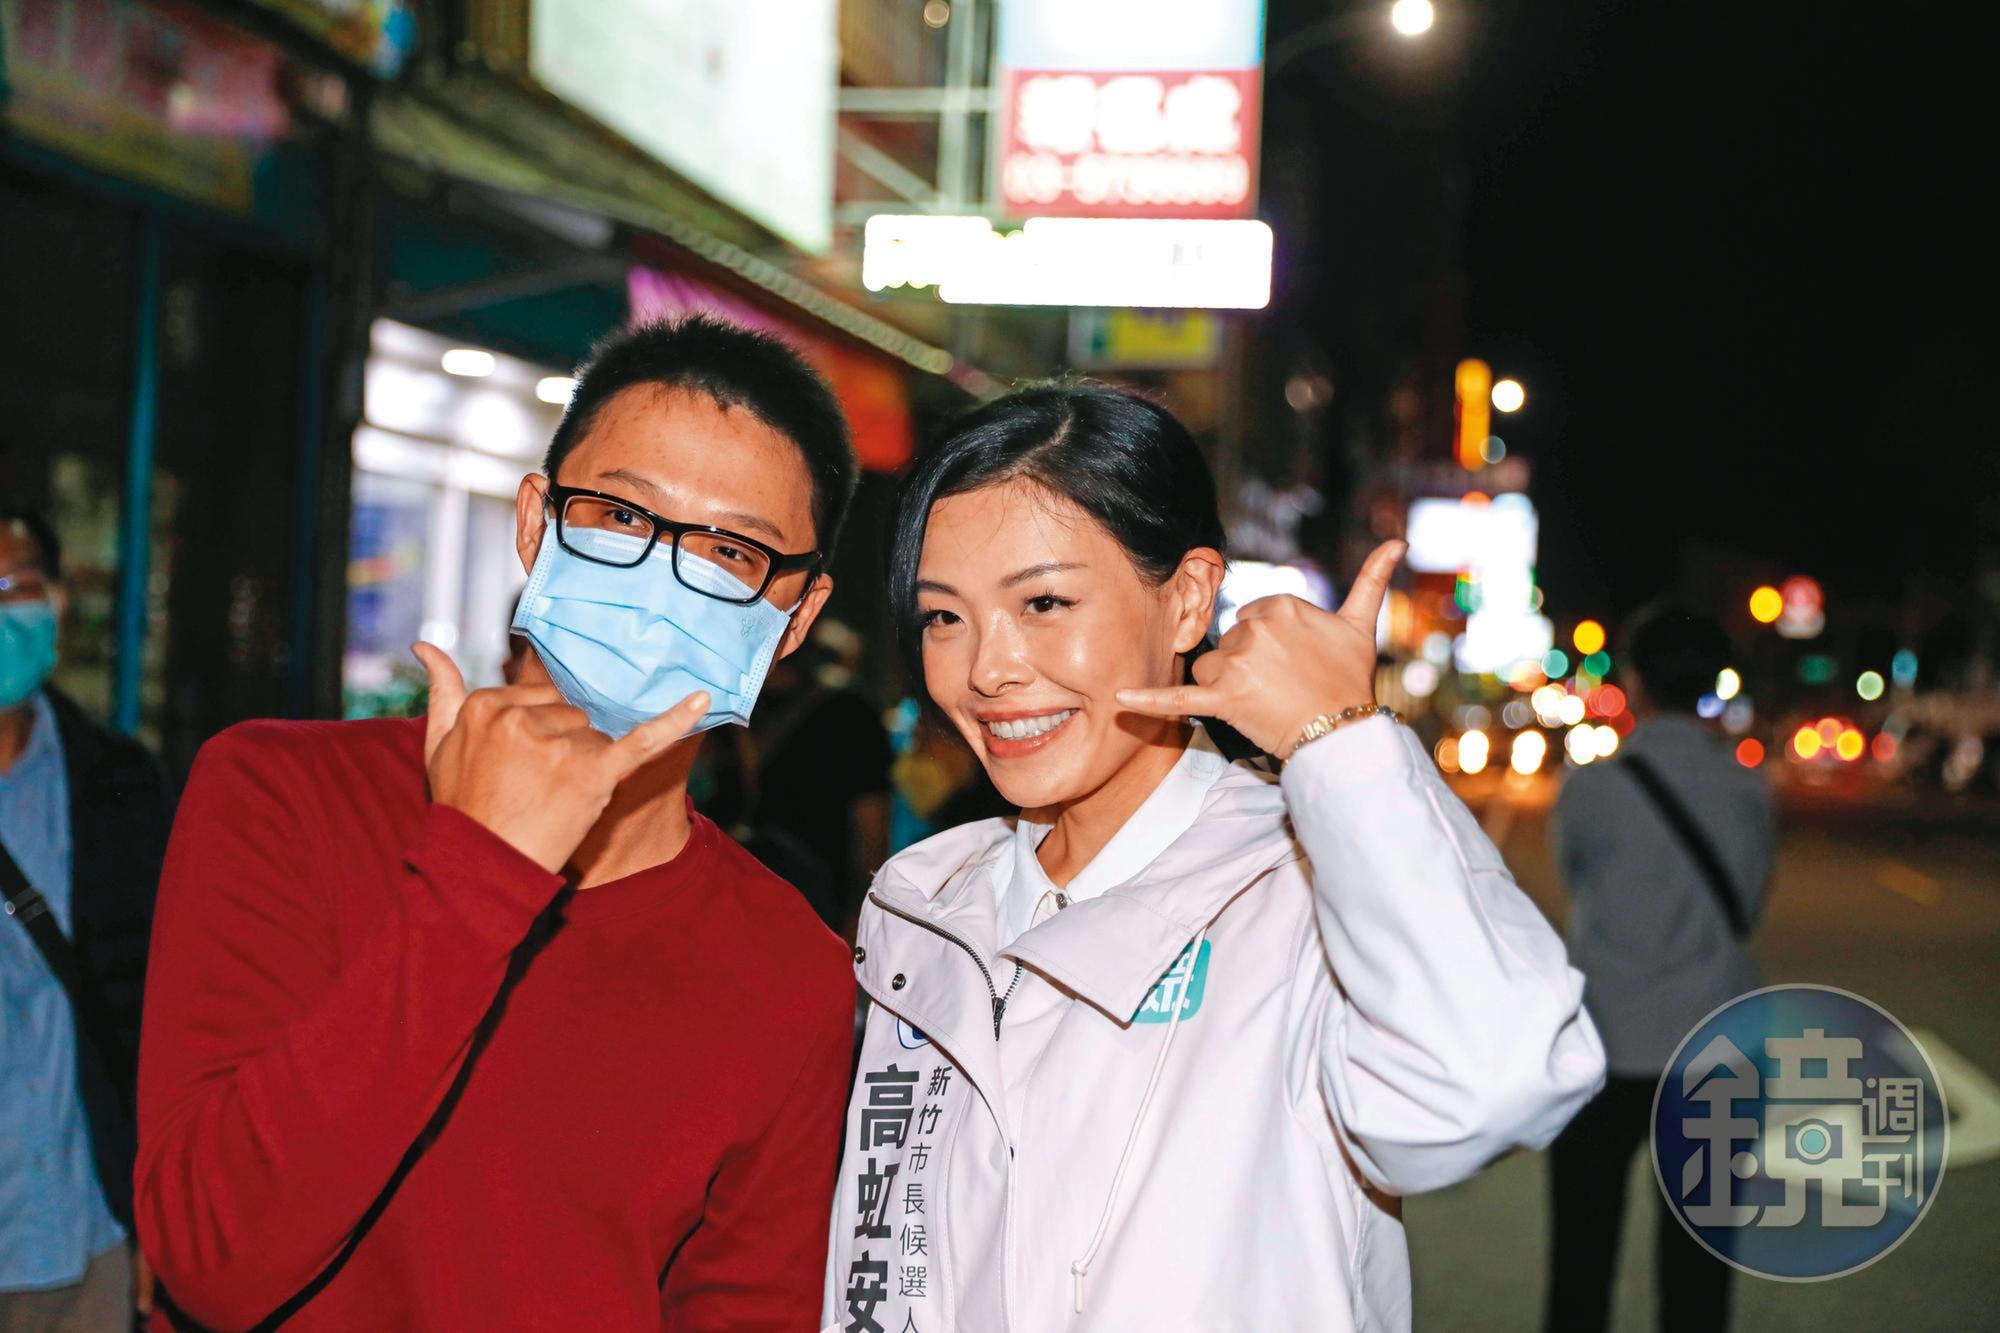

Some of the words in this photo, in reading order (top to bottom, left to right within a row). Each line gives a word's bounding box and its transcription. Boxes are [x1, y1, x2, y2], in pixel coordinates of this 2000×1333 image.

[844, 1063, 919, 1333] 高虹安
[899, 1066, 952, 1333] 新竹市長候選人
